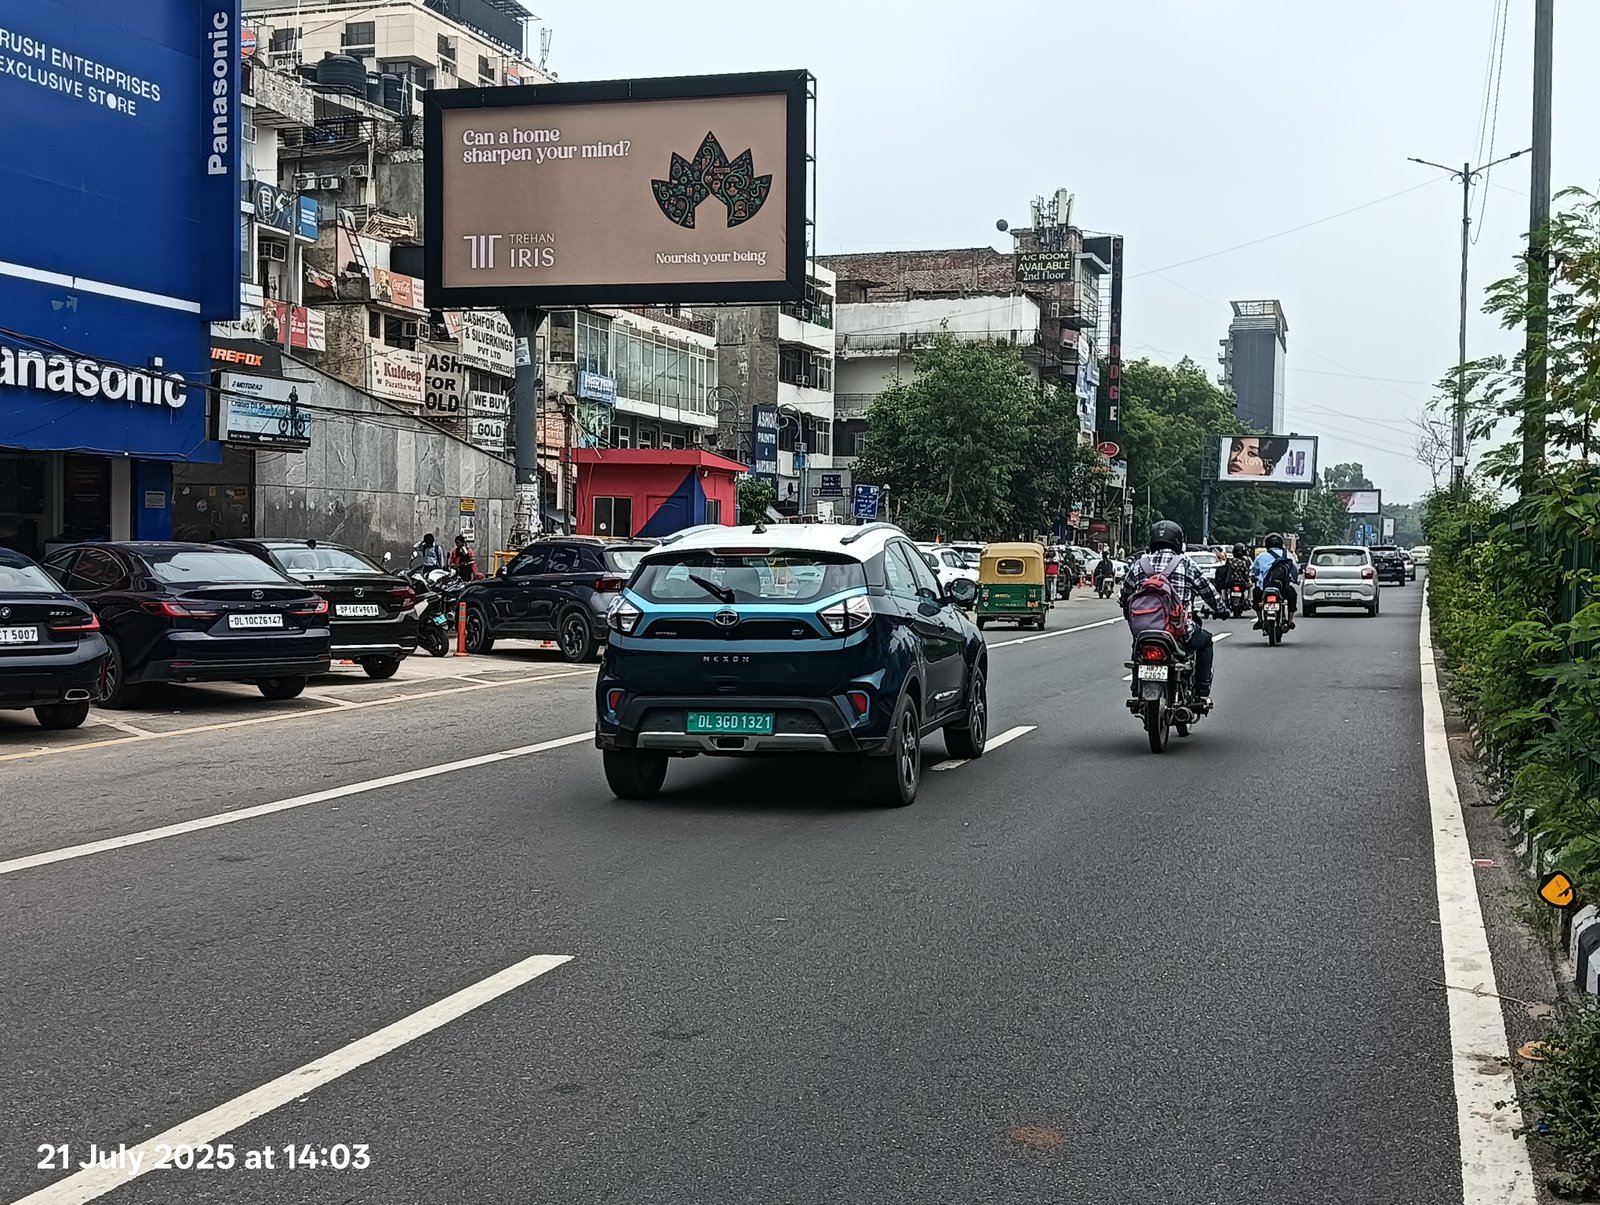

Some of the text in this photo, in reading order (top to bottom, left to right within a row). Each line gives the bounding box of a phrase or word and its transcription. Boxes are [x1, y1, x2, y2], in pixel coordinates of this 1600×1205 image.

[0, 28, 161, 101] RUSH ENTERPRISES
[0, 55, 136, 116] EXCLUSIVE STORE
[208, 11, 229, 175] Panasonic
[463, 127, 560, 145] Can a home
[463, 140, 631, 165] sharpen your mind?
[509, 233, 555, 244] TREHAN
[510, 247, 554, 268] IRIS
[656, 250, 767, 266] Nourish your being
[1017, 260, 1070, 271] AVAILABLE
[1021, 252, 1069, 261] A/C ROOM
[1023, 270, 1066, 280] 2nd floor
[471, 328, 513, 353] SILVERKINGS
[210, 347, 263, 366] IREFOX
[478, 345, 502, 360] PVT LTD
[425, 353, 462, 373] ASH
[383, 361, 422, 385] Kuldeep
[420, 392, 460, 412] OLD
[474, 393, 506, 410] WE BUY
[477, 422, 502, 438] GOLD
[757, 432, 776, 444] PAINTS
[11, 629, 36, 640] 5007
